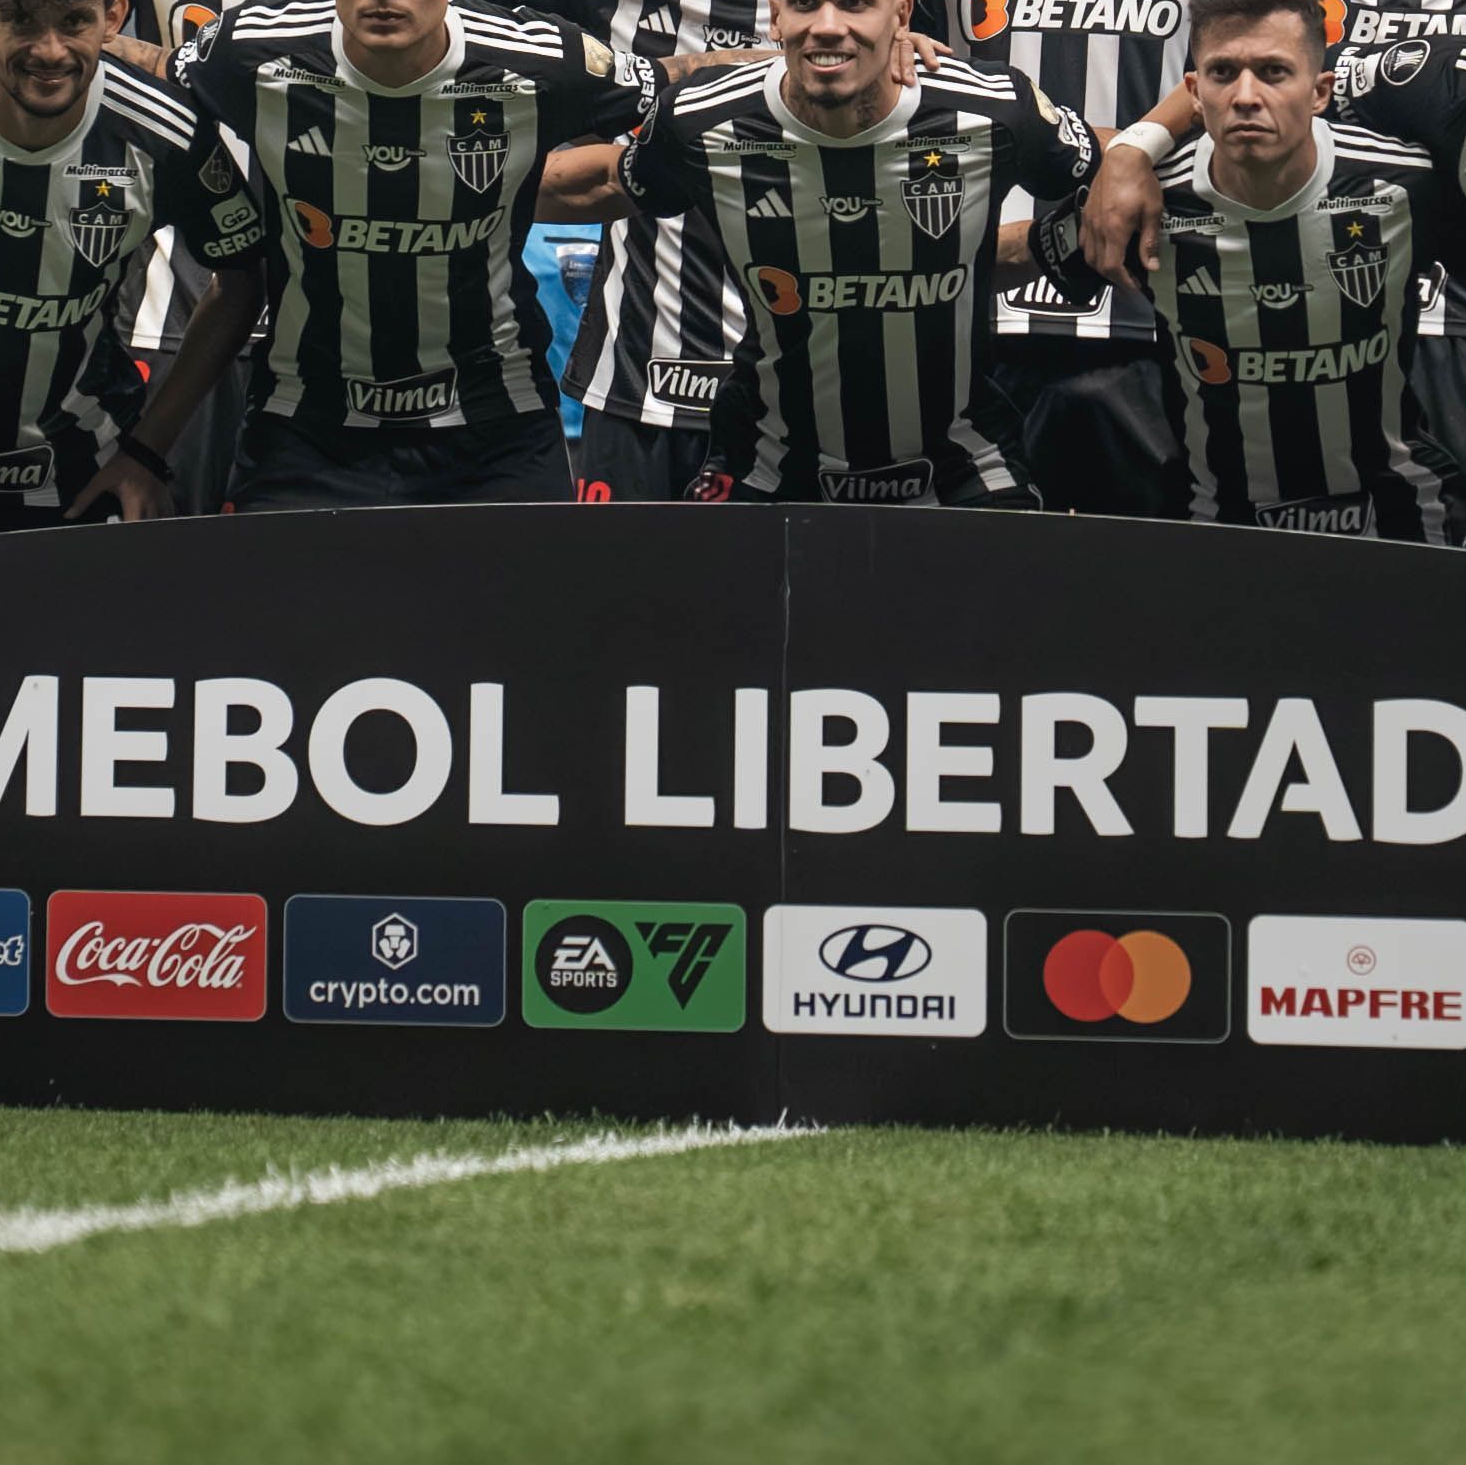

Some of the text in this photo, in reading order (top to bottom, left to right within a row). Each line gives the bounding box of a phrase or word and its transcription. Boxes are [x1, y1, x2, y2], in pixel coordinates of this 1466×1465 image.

[704, 26, 739, 46] YOU
[442, 83, 518, 95] Multimarcas
[637, 56, 655, 114] GERD
[364, 144, 405, 161] YOU
[456, 138, 502, 152] CAM
[910, 180, 957, 196] CAM
[820, 197, 861, 213] YOU
[1317, 195, 1393, 211] Multimarcas
[78, 213, 124, 226] CAM
[337, 206, 505, 253] BETANO
[1161, 215, 1225, 230] ultimarcas
[204, 228, 264, 258] GERD
[1336, 250, 1383, 267] CAM
[808, 267, 965, 310] BETANO
[1251, 283, 1290, 301] YOU
[1238, 334, 1389, 383] BETANO
[653, 364, 718, 400] Vilm
[354, 383, 446, 413] Vilma
[823, 475, 921, 500] Vilma
[1263, 505, 1362, 533] Vilma
[55, 921, 257, 989] Coca-Cola
[551, 936, 616, 970] EA
[550, 970, 617, 989] SPORTS
[309, 976, 480, 1010] crypto.com
[793, 991, 956, 1020] HYUNDAI
[1260, 987, 1462, 1021] MAPFRE
